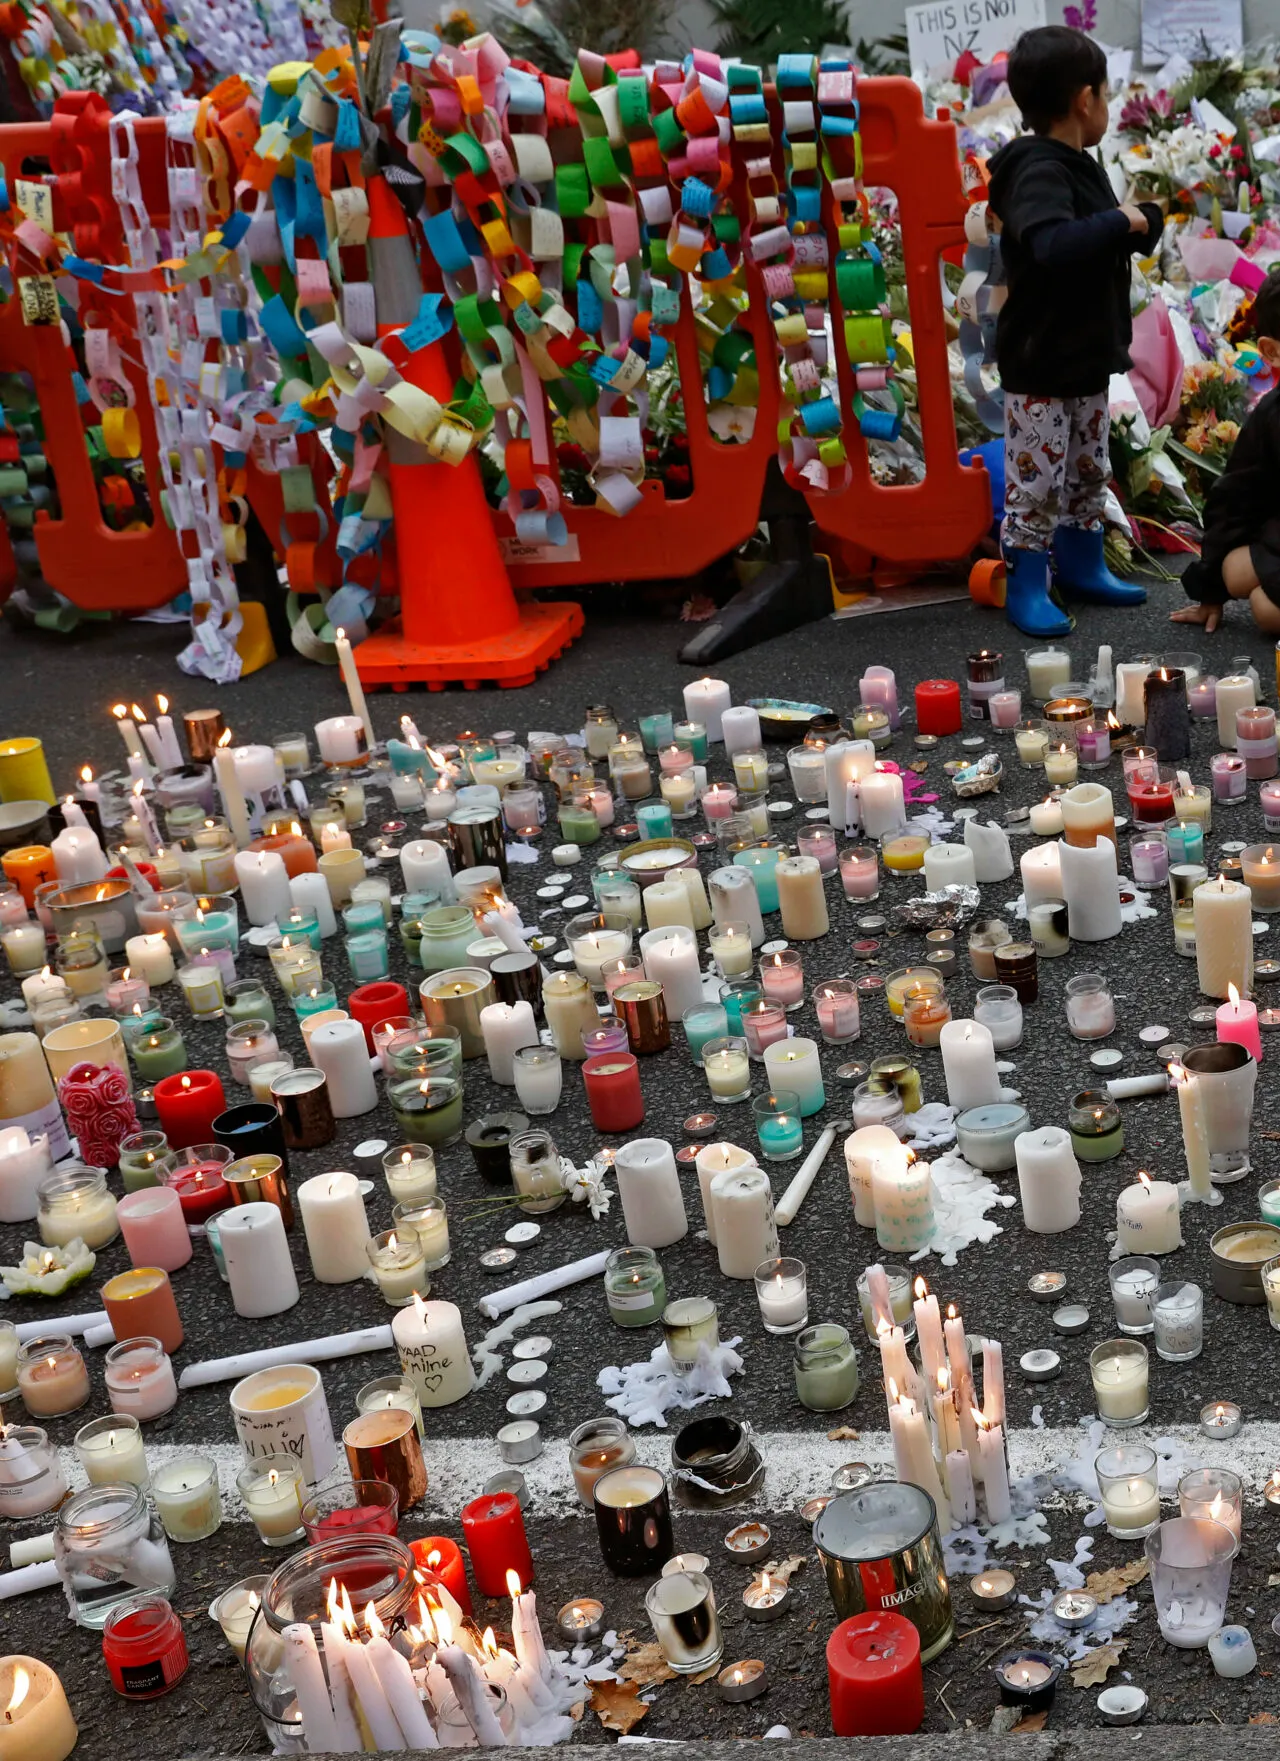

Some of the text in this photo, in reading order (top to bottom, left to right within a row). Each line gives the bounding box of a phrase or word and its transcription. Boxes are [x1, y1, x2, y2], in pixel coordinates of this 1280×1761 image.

[915, 6, 957, 34] THIS
[963, 2, 982, 25] IS
[943, 29, 983, 60] NZ
